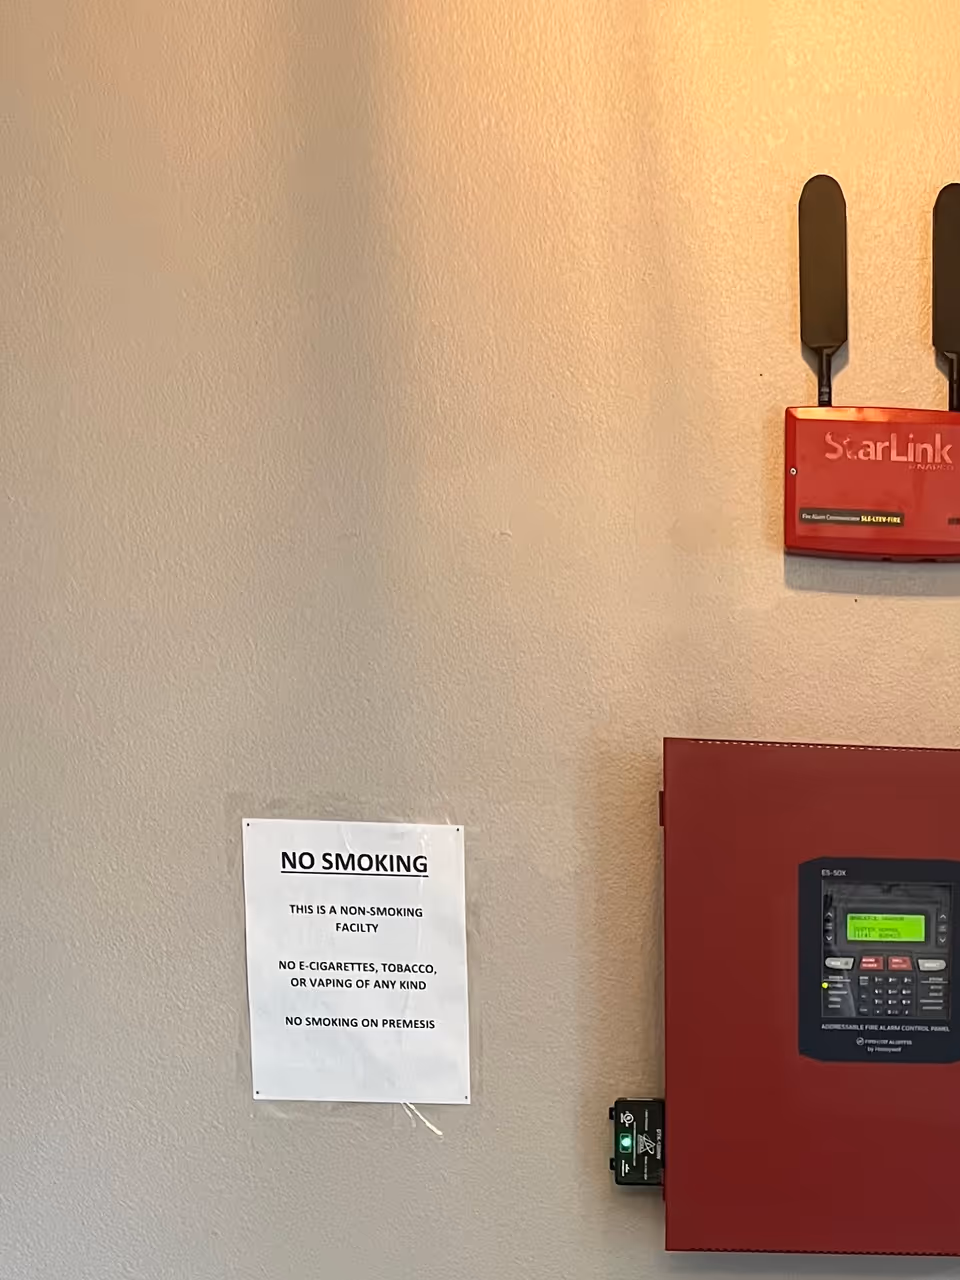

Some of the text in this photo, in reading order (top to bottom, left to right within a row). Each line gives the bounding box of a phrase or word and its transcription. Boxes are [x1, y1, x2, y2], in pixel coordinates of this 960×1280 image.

[824, 431, 953, 464] StarLink
[281, 851, 428, 873] NO SMOKING
[289, 904, 423, 918] THIS IS A NON-SMOKING
[335, 922, 379, 933] FACILTY
[278, 960, 437, 975] NO E-CIGARETTES, TOBACCO,
[290, 977, 427, 990] OR VAPING OF ANY KIND
[285, 1016, 436, 1029] NO SMOKING ON PREMESIS
